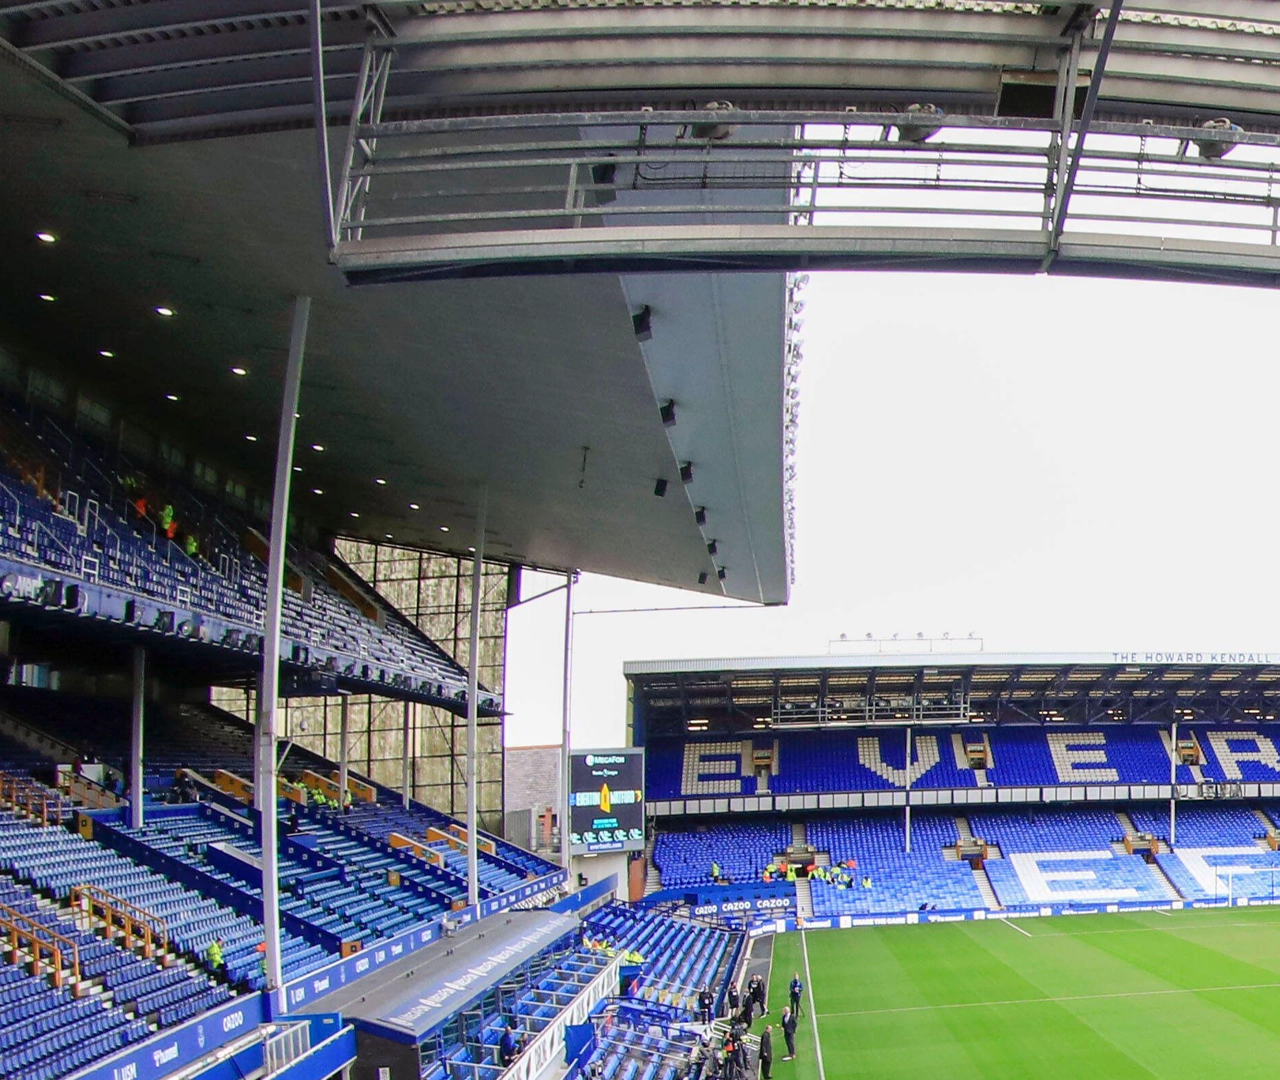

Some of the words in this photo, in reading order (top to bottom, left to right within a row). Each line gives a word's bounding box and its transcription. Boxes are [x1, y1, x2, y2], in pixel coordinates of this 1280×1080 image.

[1113, 653, 1138, 663] THE
[1145, 653, 1203, 663] HOWARD
[1211, 653, 1271, 664] KENDALL
[695, 905, 717, 915] CAZOO
[722, 901, 751, 912] CAZOO
[757, 898, 790, 909] CAZOO
[223, 1010, 243, 1032] CAZOO
